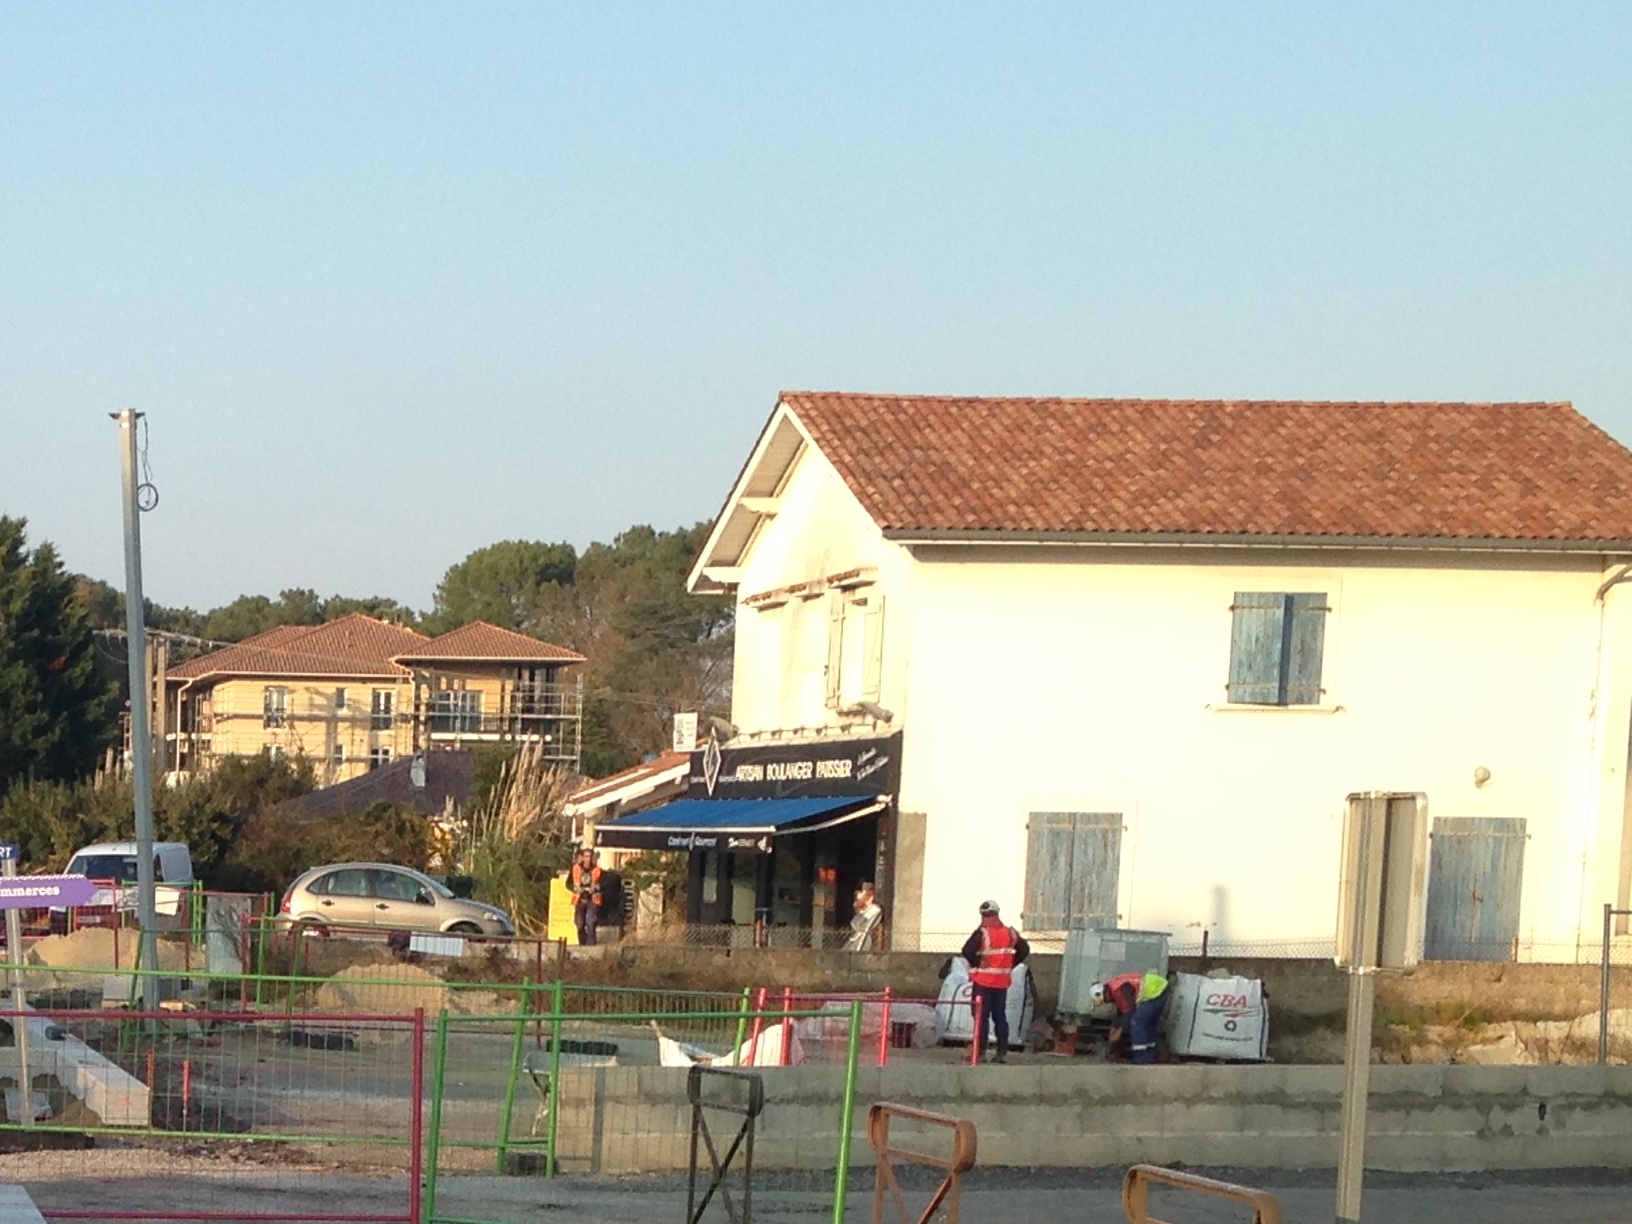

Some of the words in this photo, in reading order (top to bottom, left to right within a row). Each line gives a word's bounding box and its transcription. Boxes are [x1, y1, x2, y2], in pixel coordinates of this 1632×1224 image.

[736, 765, 764, 781] ARTISAN
[766, 761, 813, 780] BOULANGER
[1206, 993, 1248, 1008] CBA
